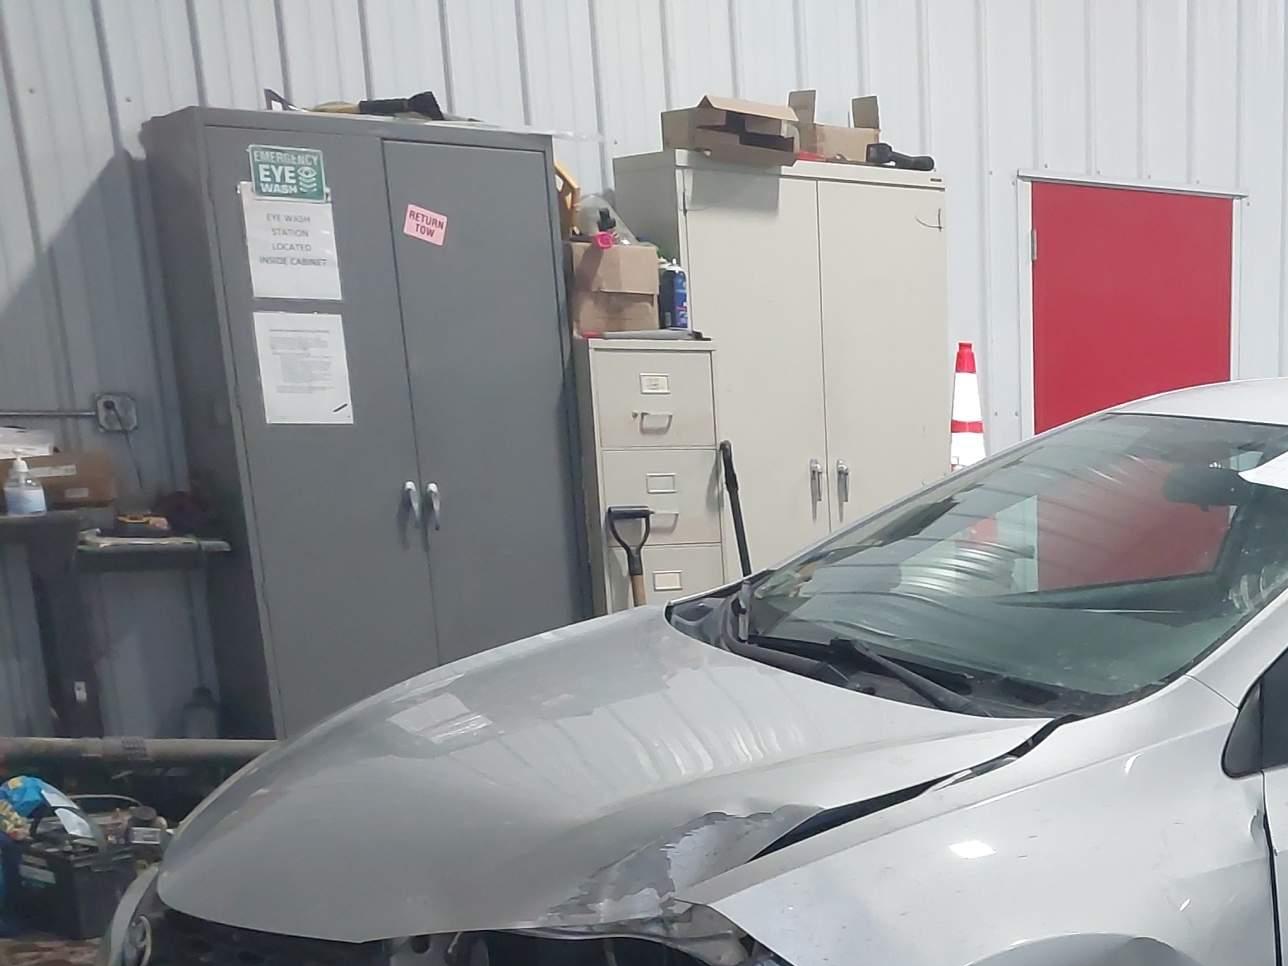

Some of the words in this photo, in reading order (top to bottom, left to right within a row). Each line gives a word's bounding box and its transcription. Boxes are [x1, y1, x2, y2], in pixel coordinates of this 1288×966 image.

[253, 150, 319, 166] EMERGENCY
[258, 164, 297, 184] EYE
[260, 183, 298, 194] WASH
[266, 213, 281, 222] EYE
[285, 214, 311, 223] WASH
[409, 210, 444, 230] RETURN
[271, 227, 309, 237] STATION
[415, 223, 435, 238] TOW
[272, 242, 312, 252] LOCATED
[259, 256, 287, 265] INSIDE
[290, 257, 327, 266] CABINET
